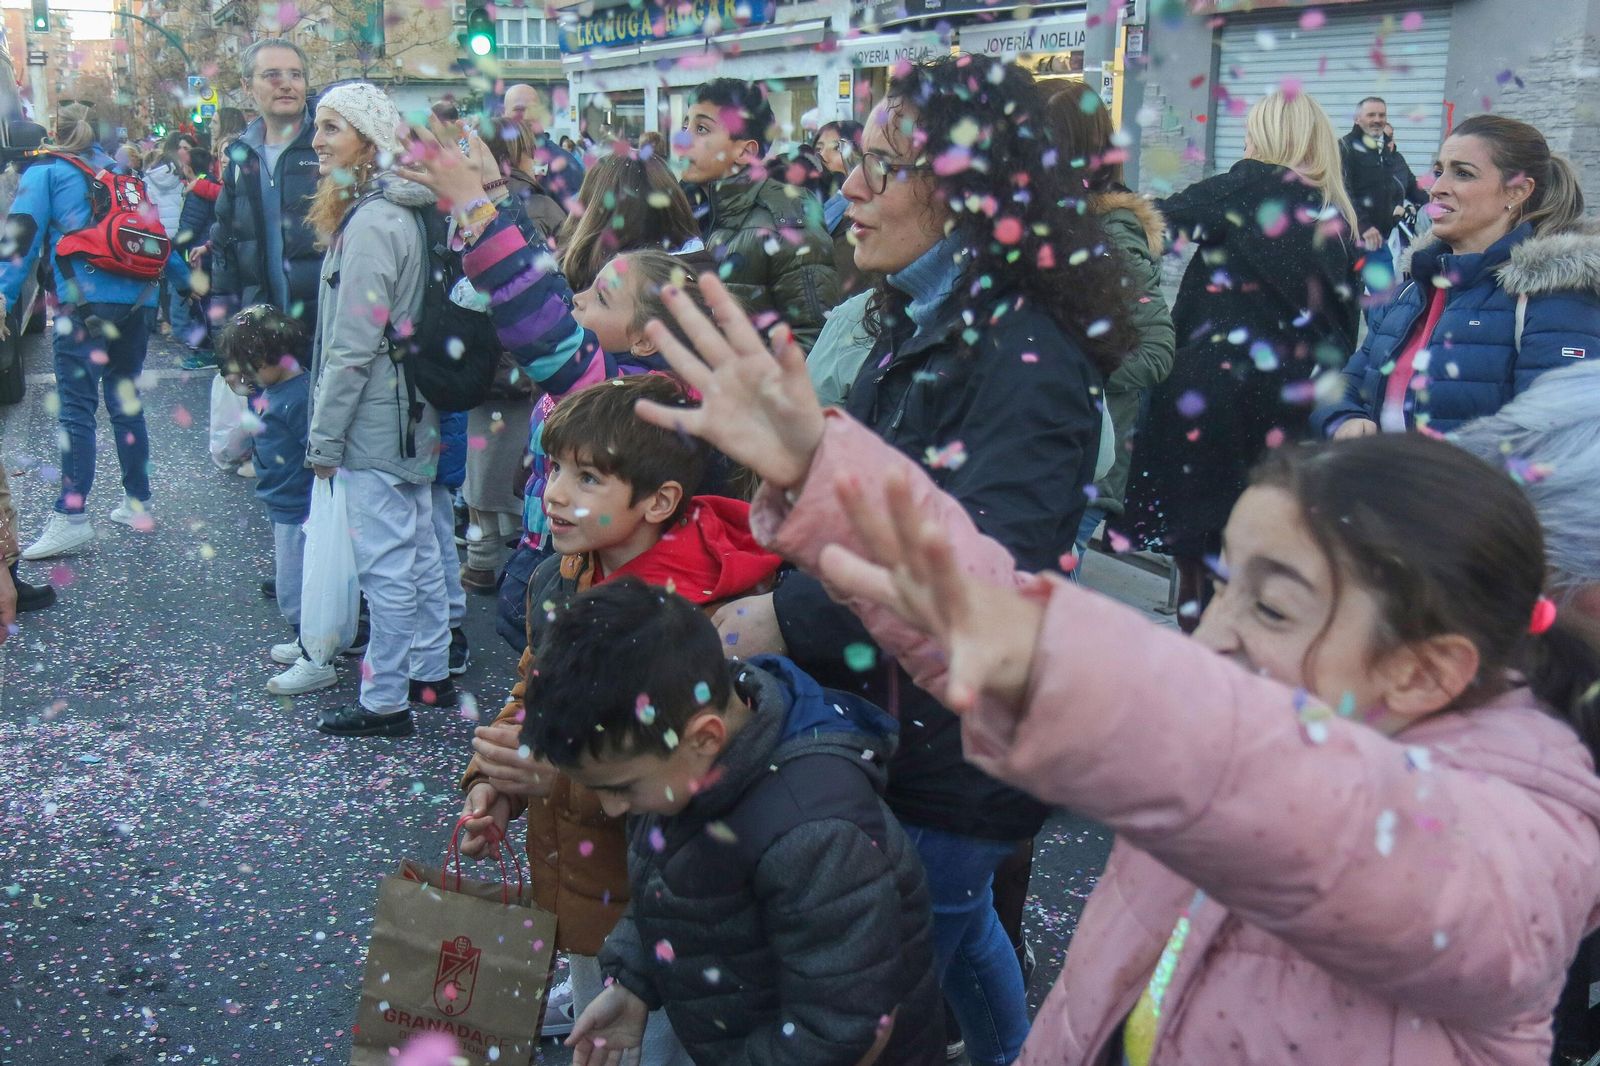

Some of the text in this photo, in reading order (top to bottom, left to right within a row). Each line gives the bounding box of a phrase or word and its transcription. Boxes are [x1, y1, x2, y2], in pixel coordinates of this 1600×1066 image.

[577, 10, 652, 46] LECHUGA
[984, 30, 1086, 53] JOYERÍA NOELIA
